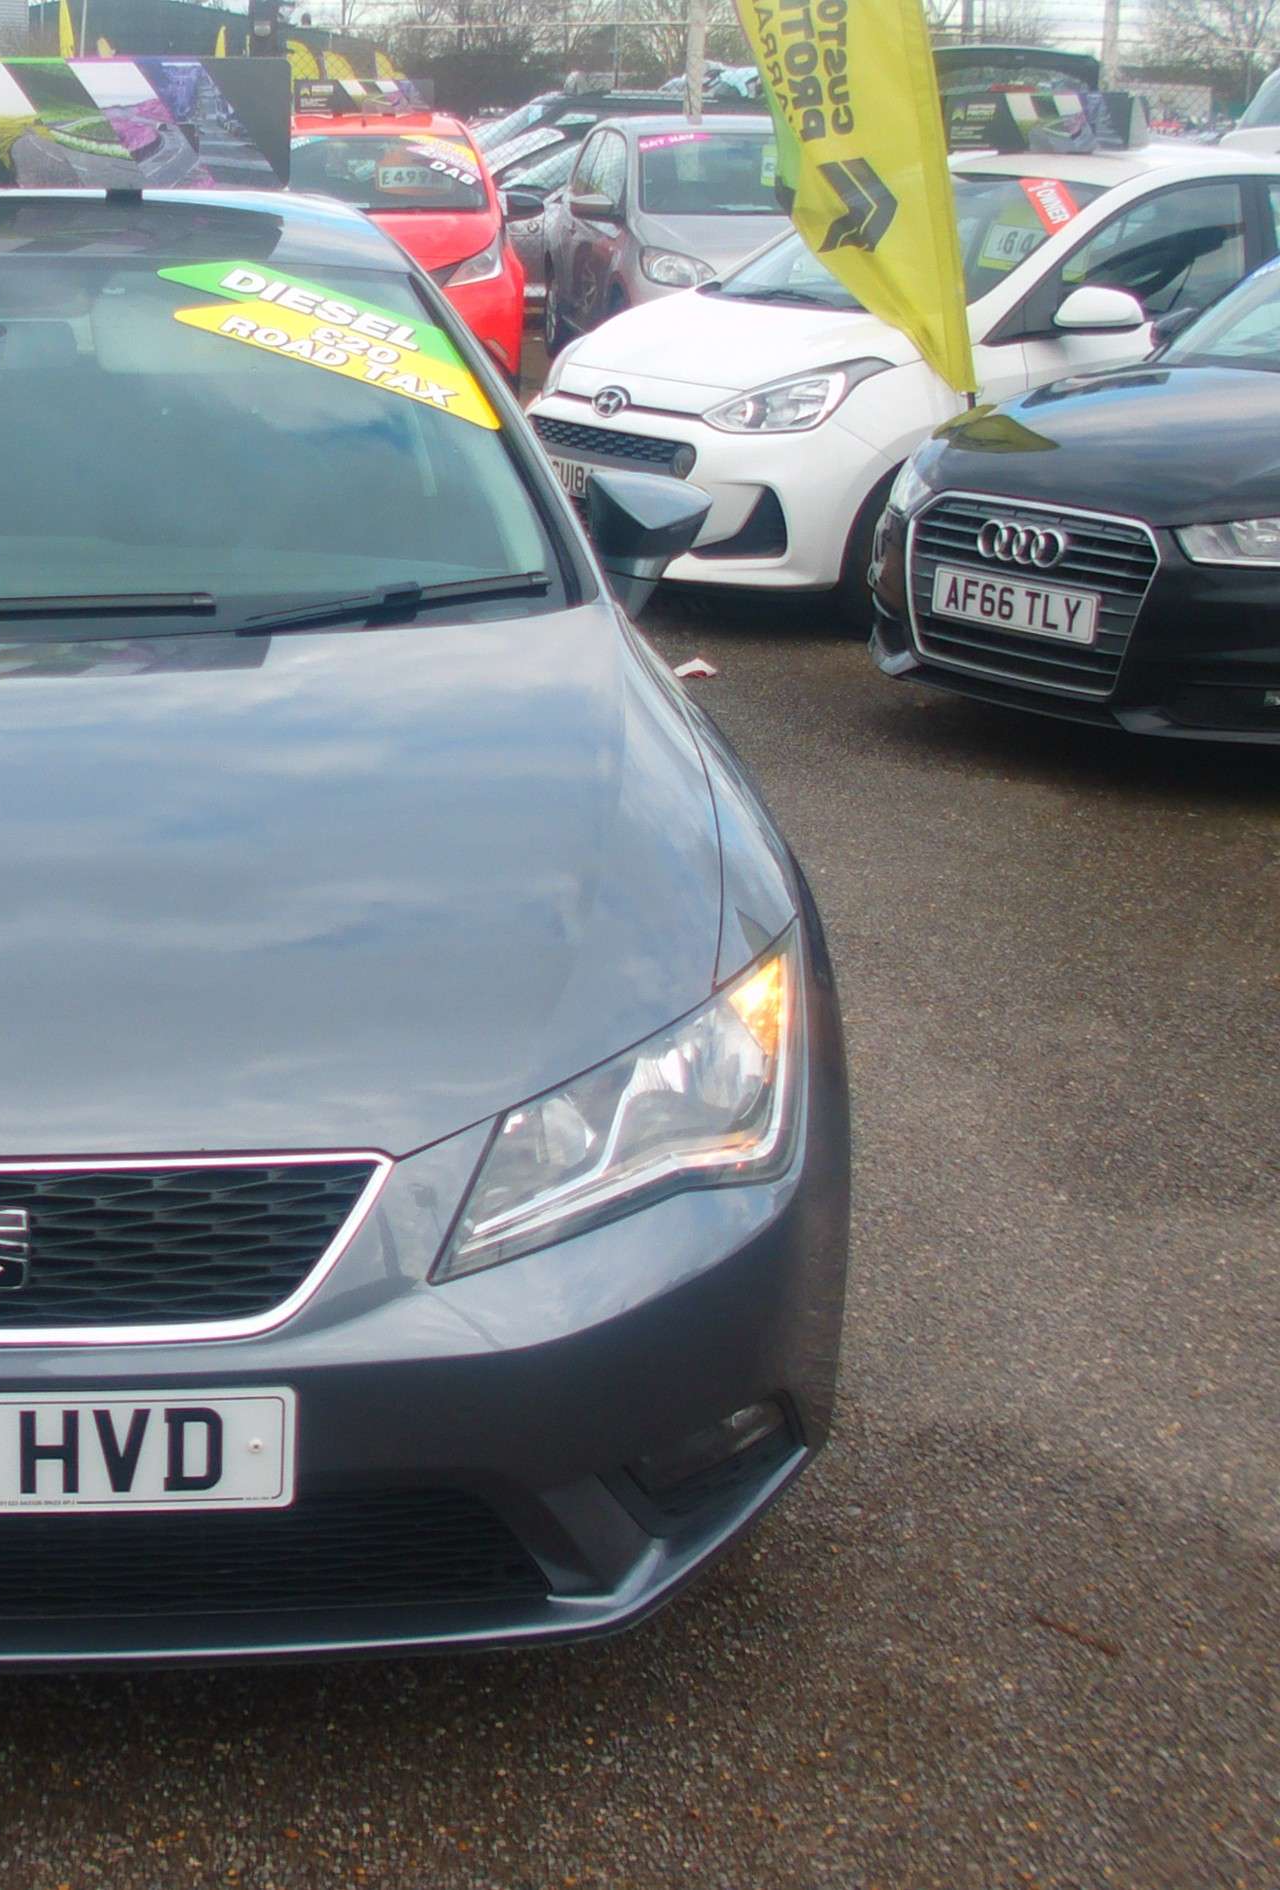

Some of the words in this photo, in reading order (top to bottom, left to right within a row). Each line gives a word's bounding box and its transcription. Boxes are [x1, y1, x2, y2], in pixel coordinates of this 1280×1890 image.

[429, 160, 476, 186] DAB
[219, 268, 421, 351] DIESEL
[219, 315, 349, 367] ROAD
[365, 364, 459, 407] TAX
[309, 328, 401, 365] £20
[945, 576, 1014, 620] AF66
[1025, 590, 1081, 633] TLY
[20, 1407, 224, 1495] HVD
